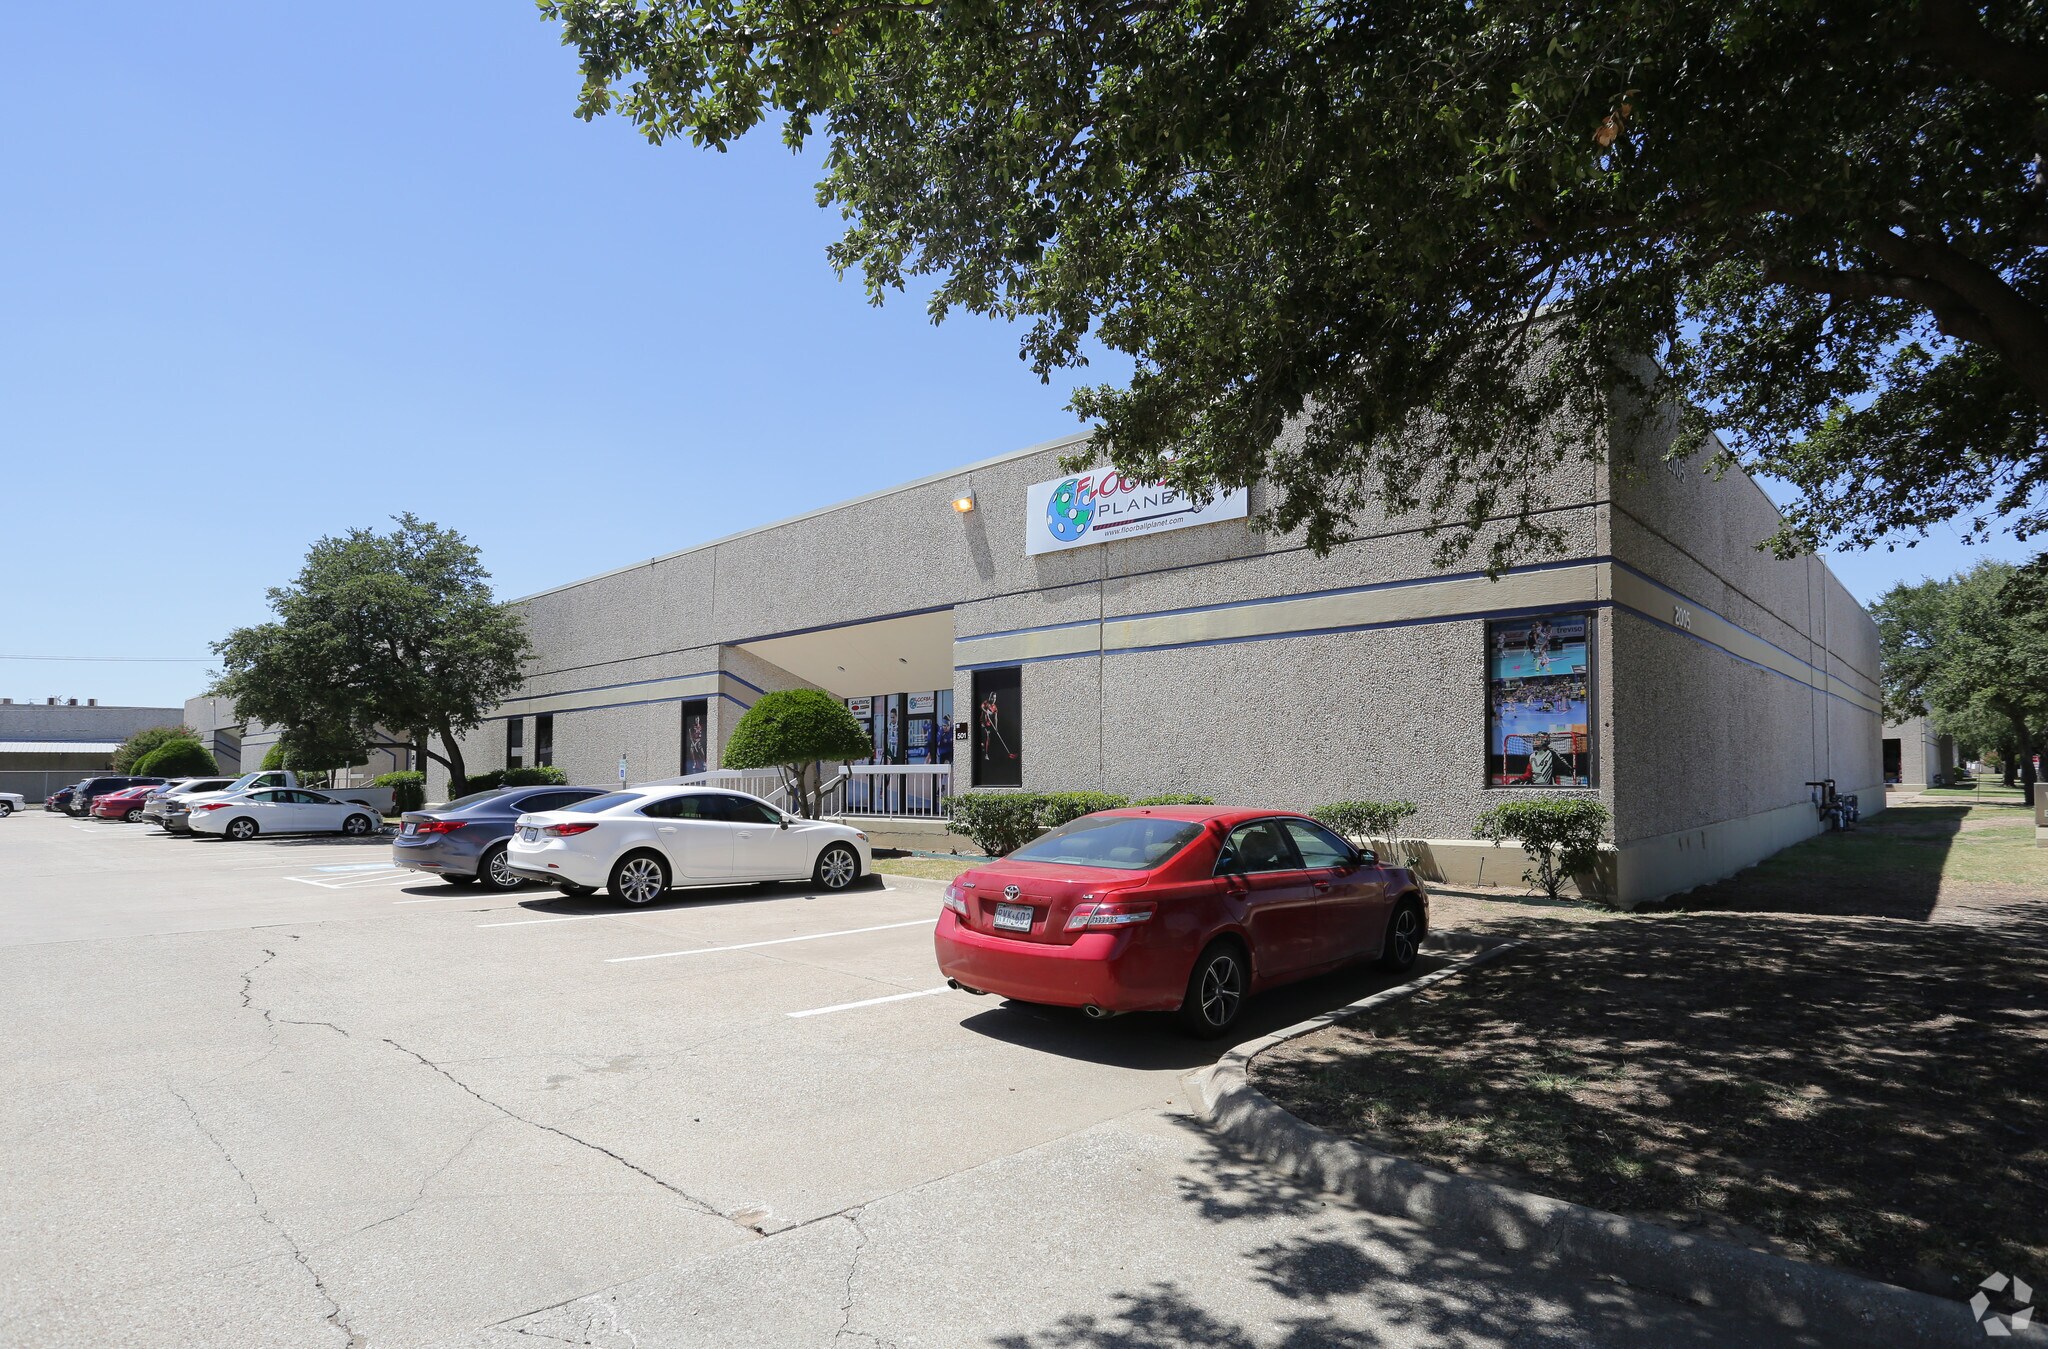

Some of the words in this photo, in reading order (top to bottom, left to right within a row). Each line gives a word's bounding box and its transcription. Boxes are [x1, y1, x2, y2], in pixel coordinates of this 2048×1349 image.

[1104, 516, 1184, 537] www.floorballplanet.com
[1557, 626, 1583, 634] treviso
[957, 732, 967, 740] 501
